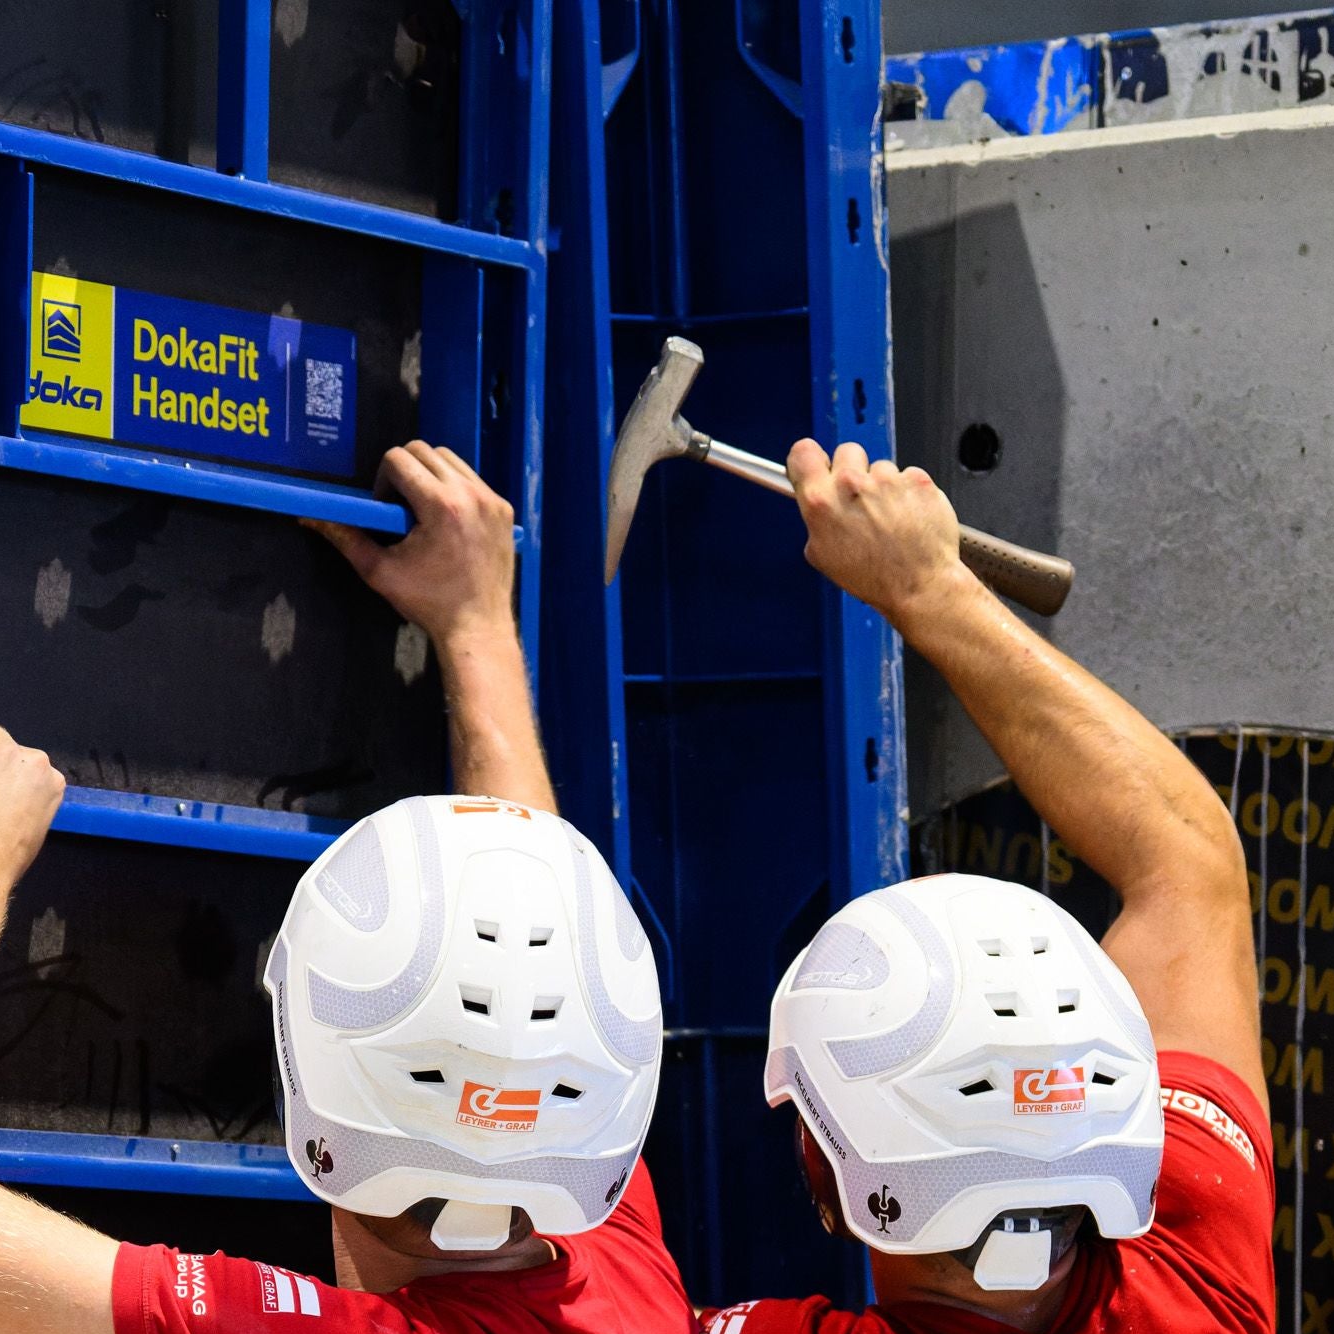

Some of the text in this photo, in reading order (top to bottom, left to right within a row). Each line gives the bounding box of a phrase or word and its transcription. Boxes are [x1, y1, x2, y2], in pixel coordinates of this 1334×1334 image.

[133, 318, 260, 382] DokaFit
[132, 373, 270, 437] Handset
[282, 1046, 297, 1096] STRAUSS
[459, 1113, 497, 1129] LEYRER
[505, 1122, 533, 1130] GRAF
[1017, 1104, 1053, 1113] LEYRER
[1060, 1102, 1083, 1111] GRAF
[819, 1120, 847, 1160] STRAUSS
[174, 1254, 189, 1298] Group
[190, 1254, 207, 1316] BAWAG
[264, 1280, 277, 1309] GRAF
